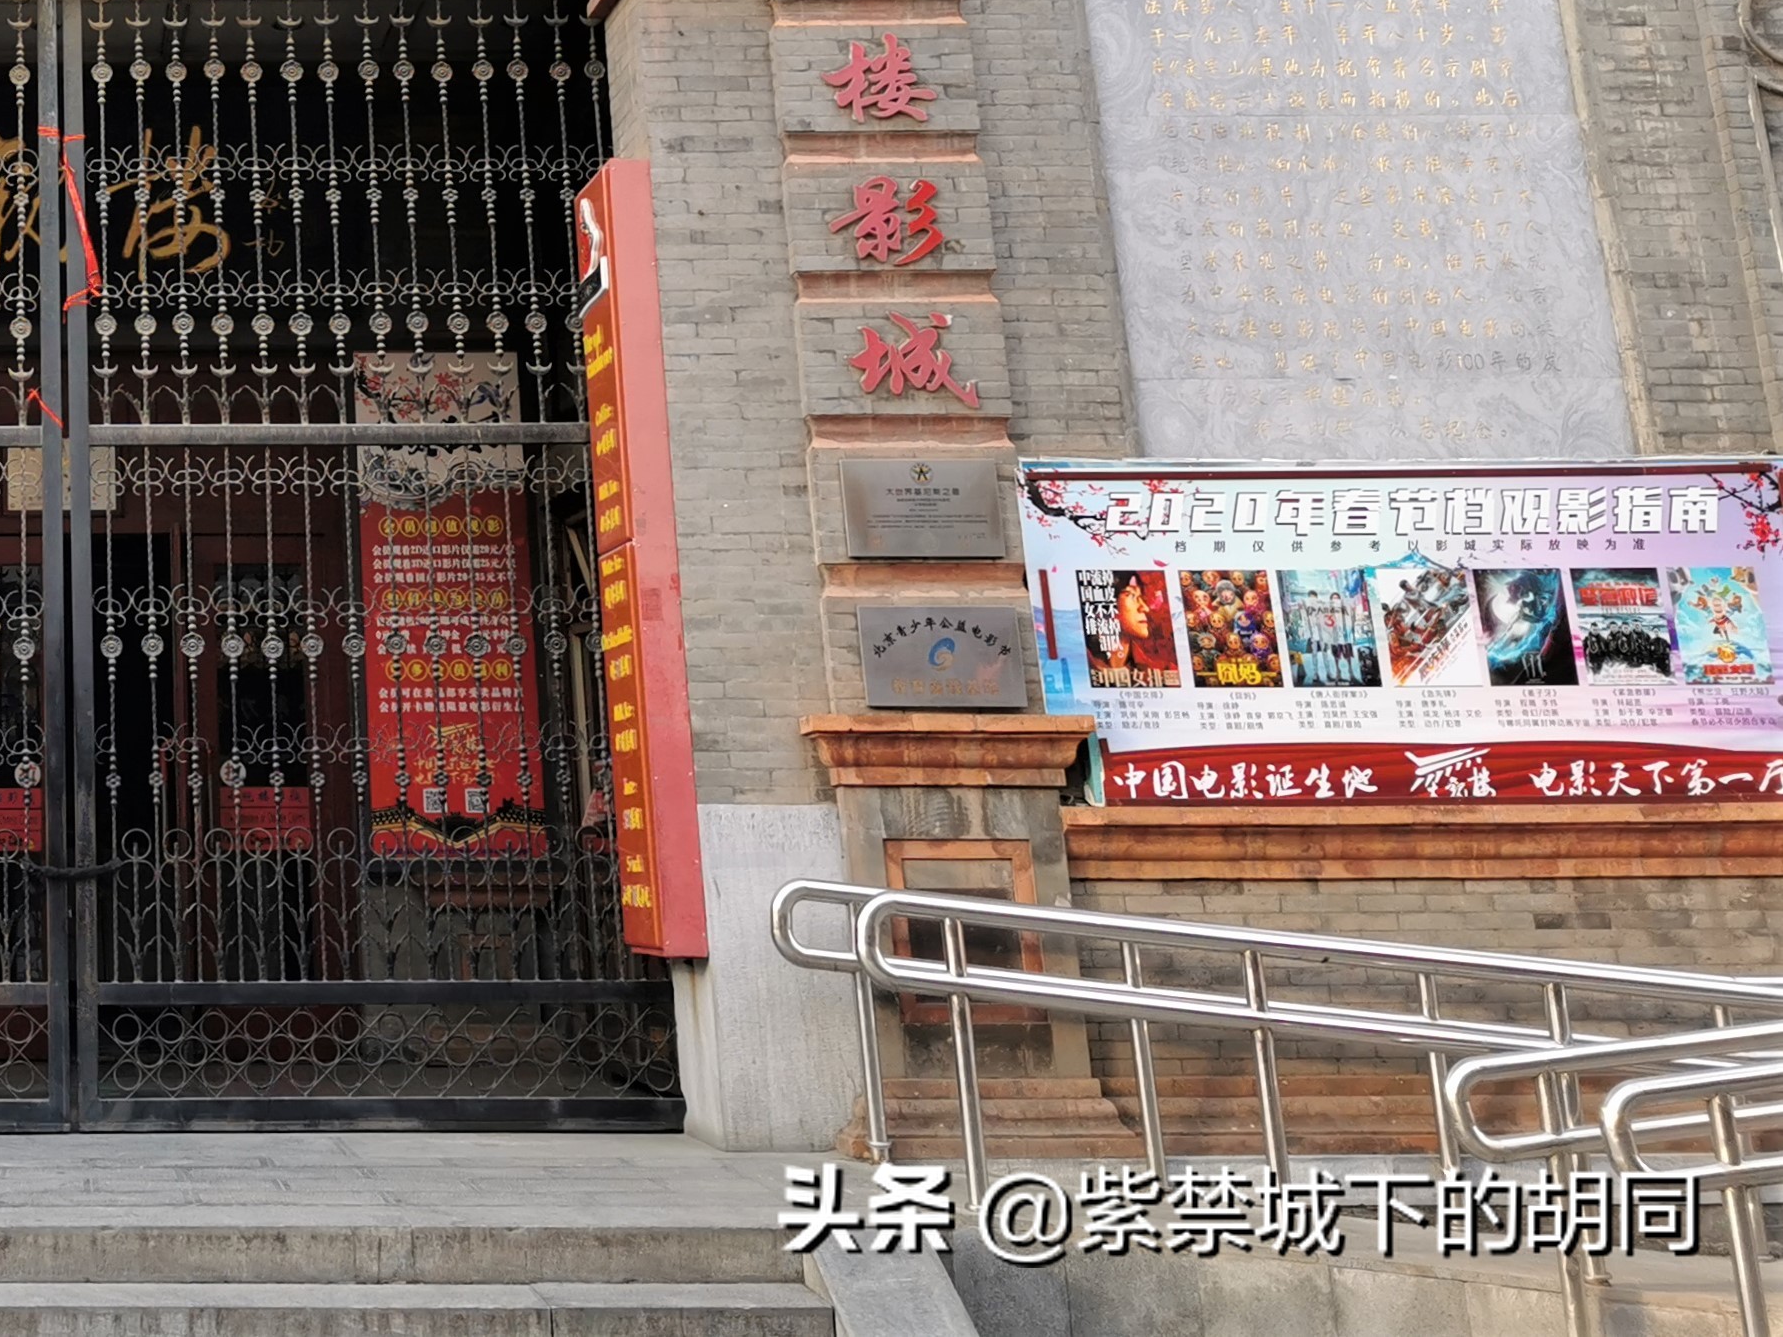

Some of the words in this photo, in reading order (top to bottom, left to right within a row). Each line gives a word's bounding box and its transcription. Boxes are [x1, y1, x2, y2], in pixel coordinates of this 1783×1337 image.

[1105, 486, 1719, 536] 2020年春节档观影指南
[873, 617, 1012, 658] 北京青少年公益电影节
[1113, 760, 1379, 800] 中国电影诞生地
